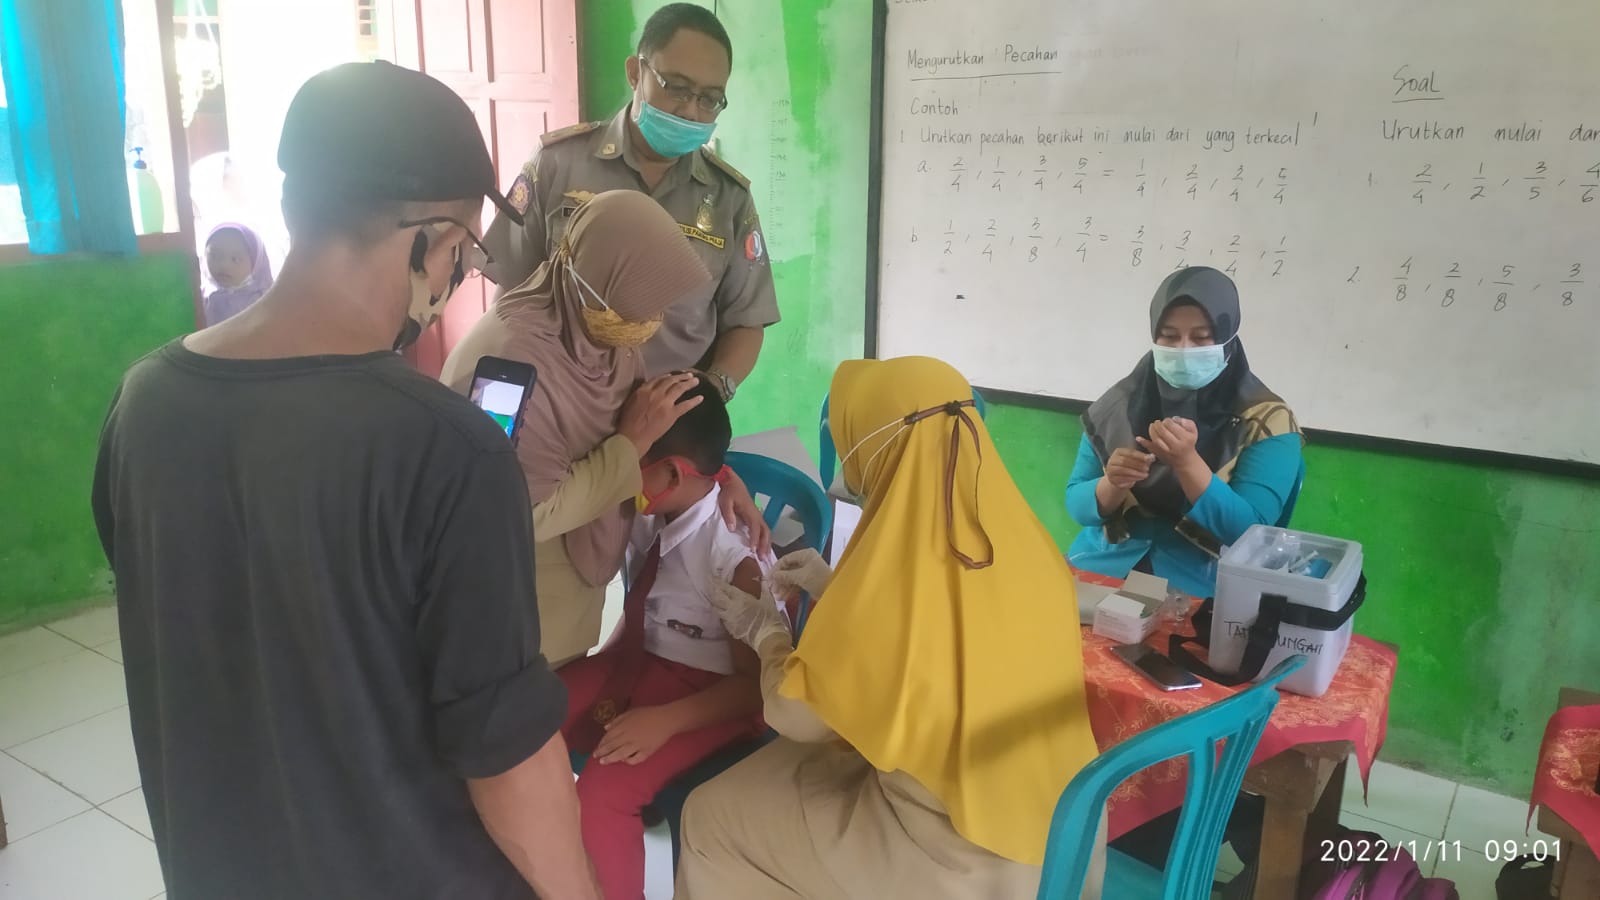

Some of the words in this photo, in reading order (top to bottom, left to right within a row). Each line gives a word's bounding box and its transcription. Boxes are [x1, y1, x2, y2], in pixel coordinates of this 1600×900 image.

[907, 49, 985, 75] Mengurutkan
[1004, 43, 1059, 63] Pecahan
[1392, 64, 1441, 96] Soal
[909, 96, 960, 117] Contoh
[919, 126, 972, 145] Urutkan
[979, 127, 1025, 157] pecahan
[1036, 125, 1084, 146] berikut
[1093, 124, 1110, 143] ini
[1165, 127, 1190, 143] dari
[1202, 128, 1236, 153] yang
[1381, 118, 1465, 143] Urutkan
